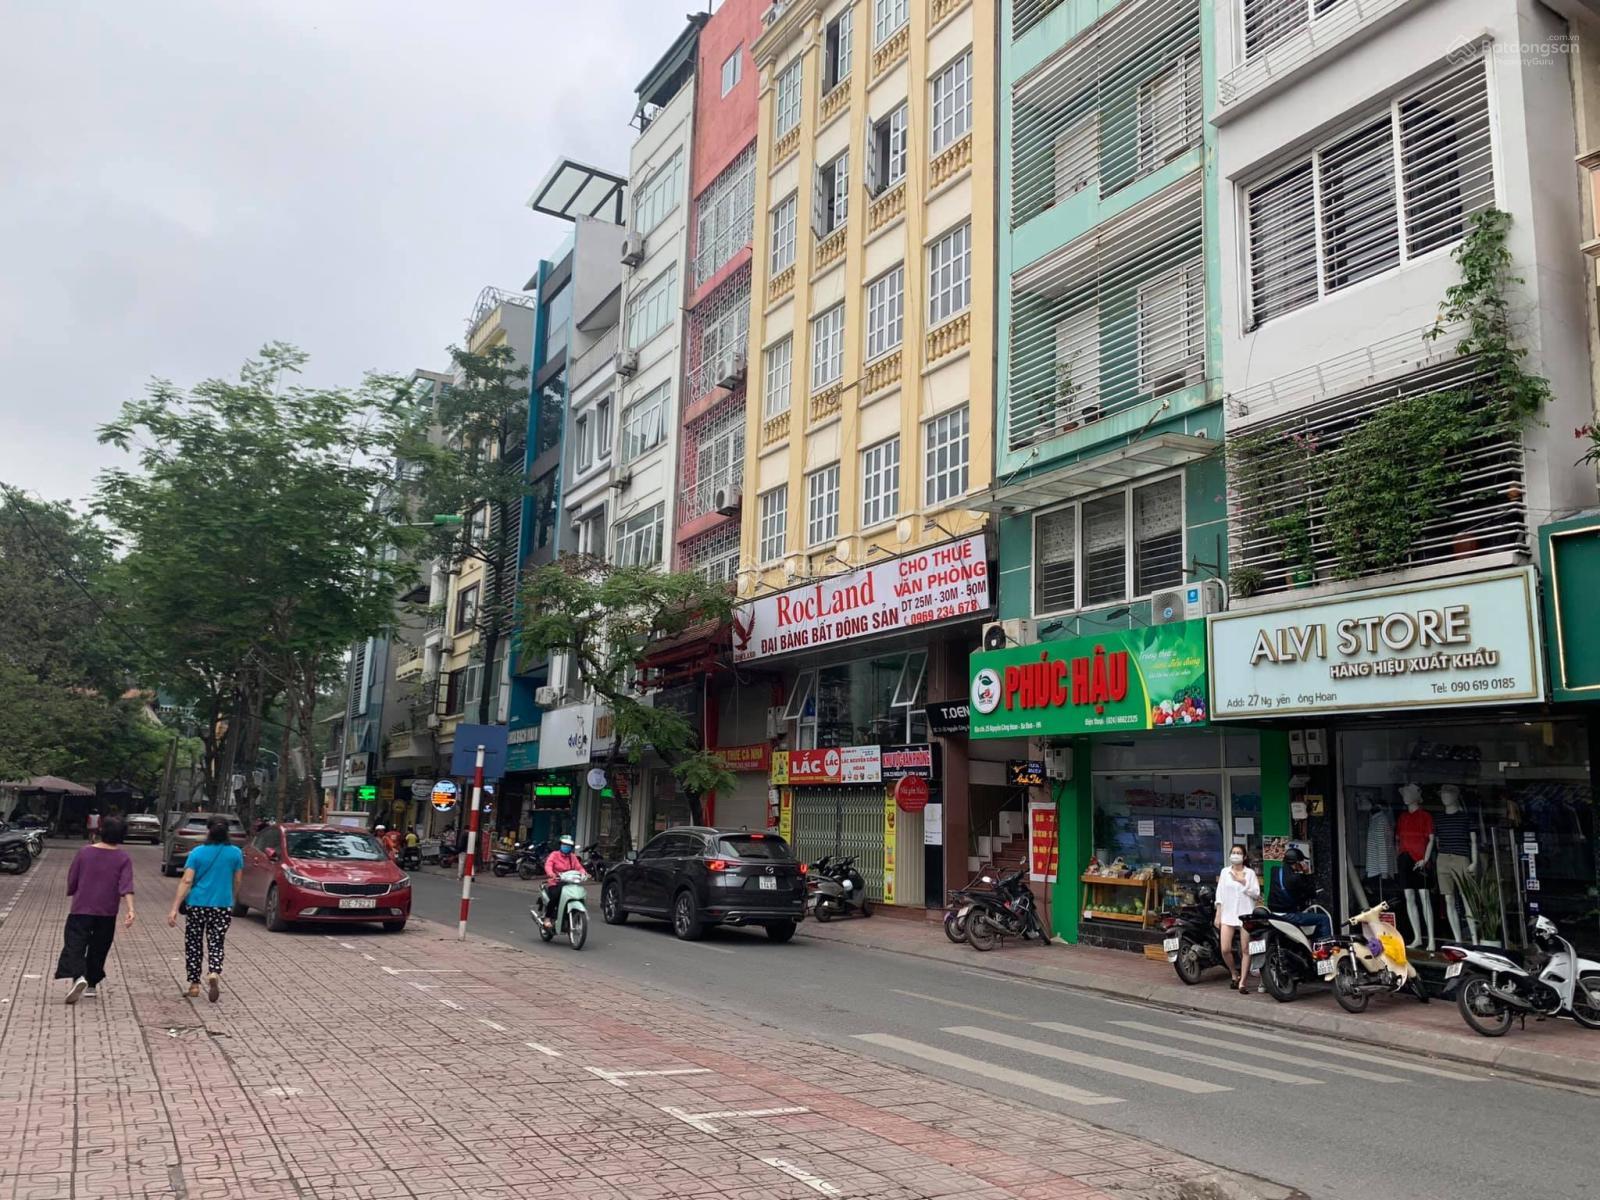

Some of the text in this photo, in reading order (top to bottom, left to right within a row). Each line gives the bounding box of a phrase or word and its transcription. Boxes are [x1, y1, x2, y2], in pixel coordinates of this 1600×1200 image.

[898, 539, 972, 578] CHO THUÊ
[894, 561, 986, 598] VĂN PHÒNG
[901, 600, 913, 613] DT
[915, 594, 933, 609] 25M
[940, 587, 958, 602] 30M
[966, 581, 987, 596] 50M
[776, 571, 875, 628] RocLand
[910, 610, 934, 625] 0969
[957, 600, 978, 613] 678
[780, 630, 809, 650] BÀNG
[811, 620, 833, 643] BẤT
[871, 602, 900, 630] SẢN
[1250, 604, 1473, 665] ALVI STORE
[1004, 644, 1128, 715] PHÚC HẬU
[1431, 677, 1515, 693] Tel: 090 619 0185
[1226, 698, 1245, 708] Add:
[1247, 694, 1260, 707] 27
[1315, 693, 1338, 702] Hoan
[792, 752, 821, 773] LẮC
